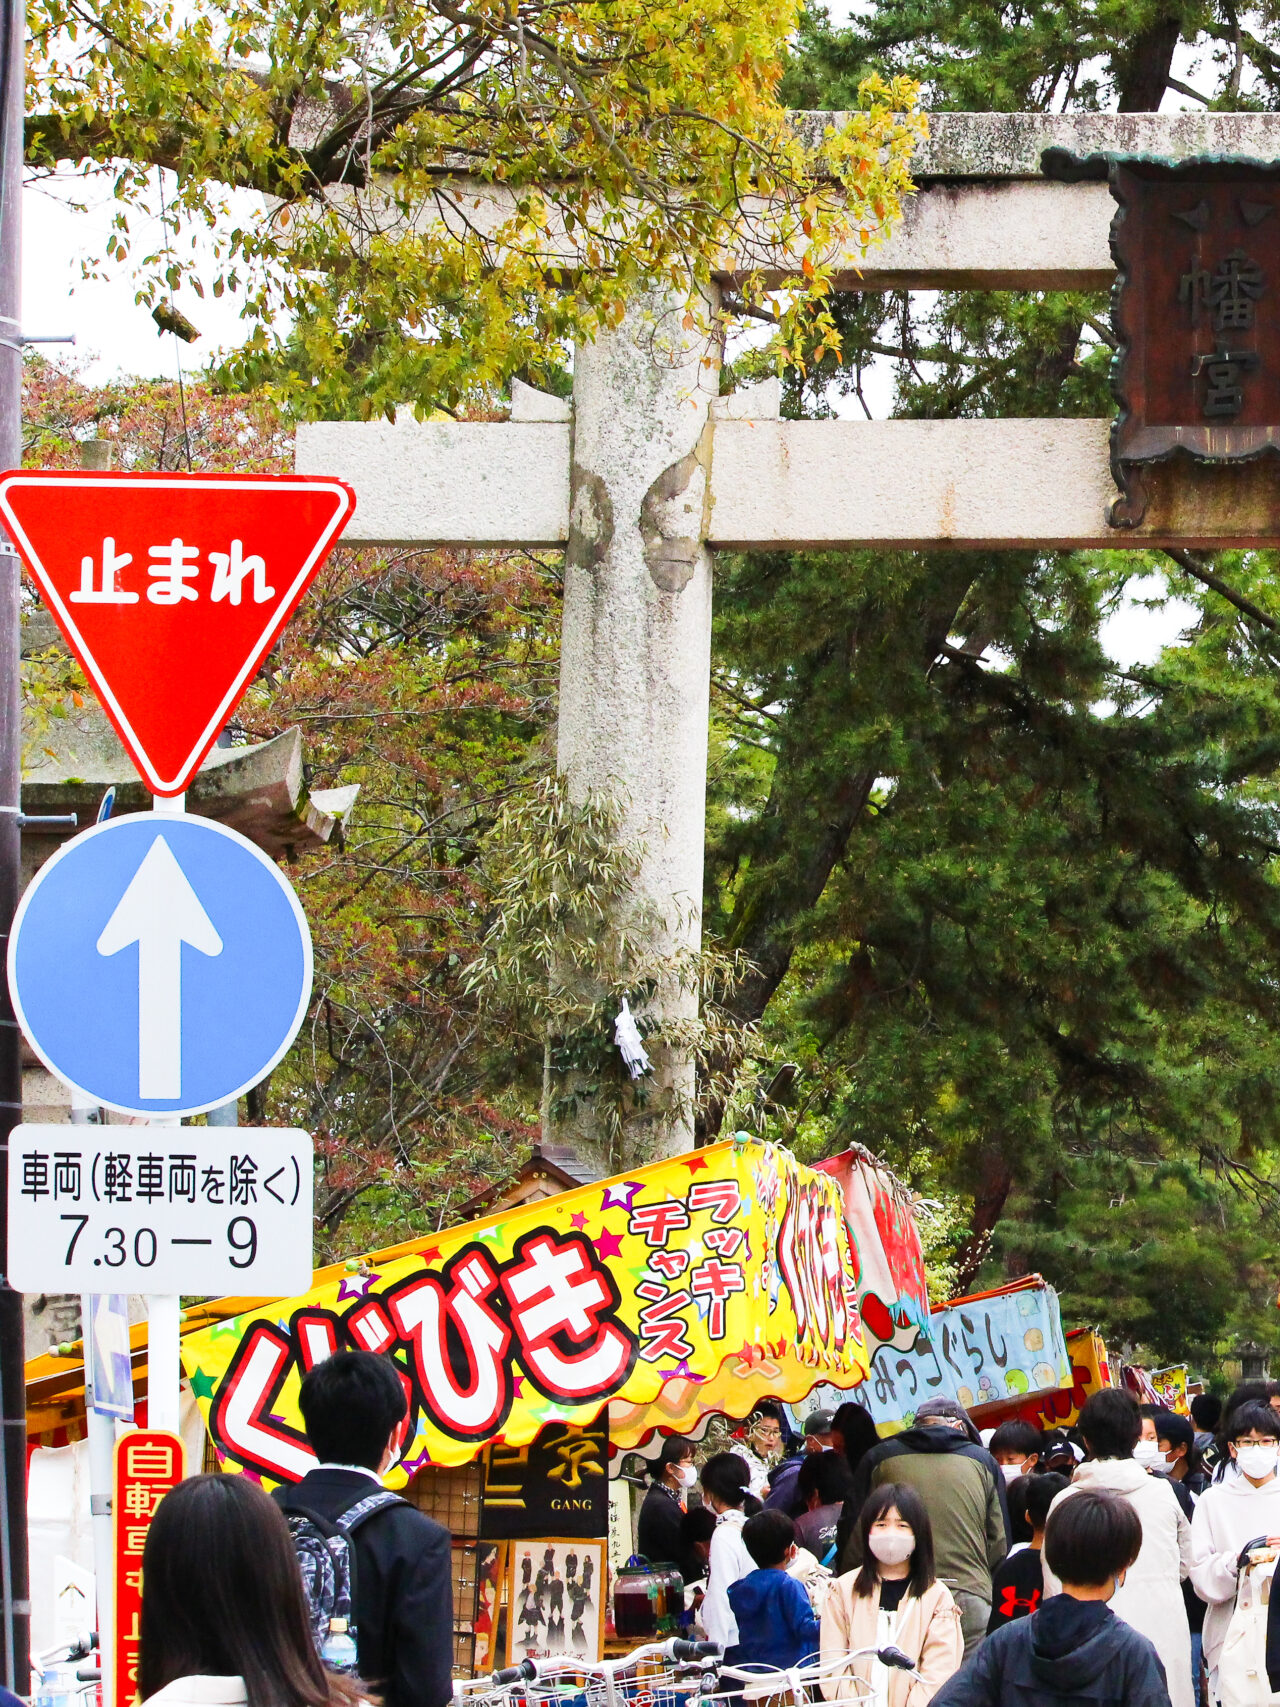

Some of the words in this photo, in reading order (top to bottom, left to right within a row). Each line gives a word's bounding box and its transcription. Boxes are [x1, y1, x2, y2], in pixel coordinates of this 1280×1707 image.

[1170, 200, 1272, 417] 八幡宮
[69, 536, 276, 606] 止まれ
[21, 1150, 300, 1205] 車両(軽車両を除く)
[628, 1200, 696, 1362] チャンス
[687, 1179, 744, 1341] ラッキー
[551, 1498, 592, 1511] GANG
